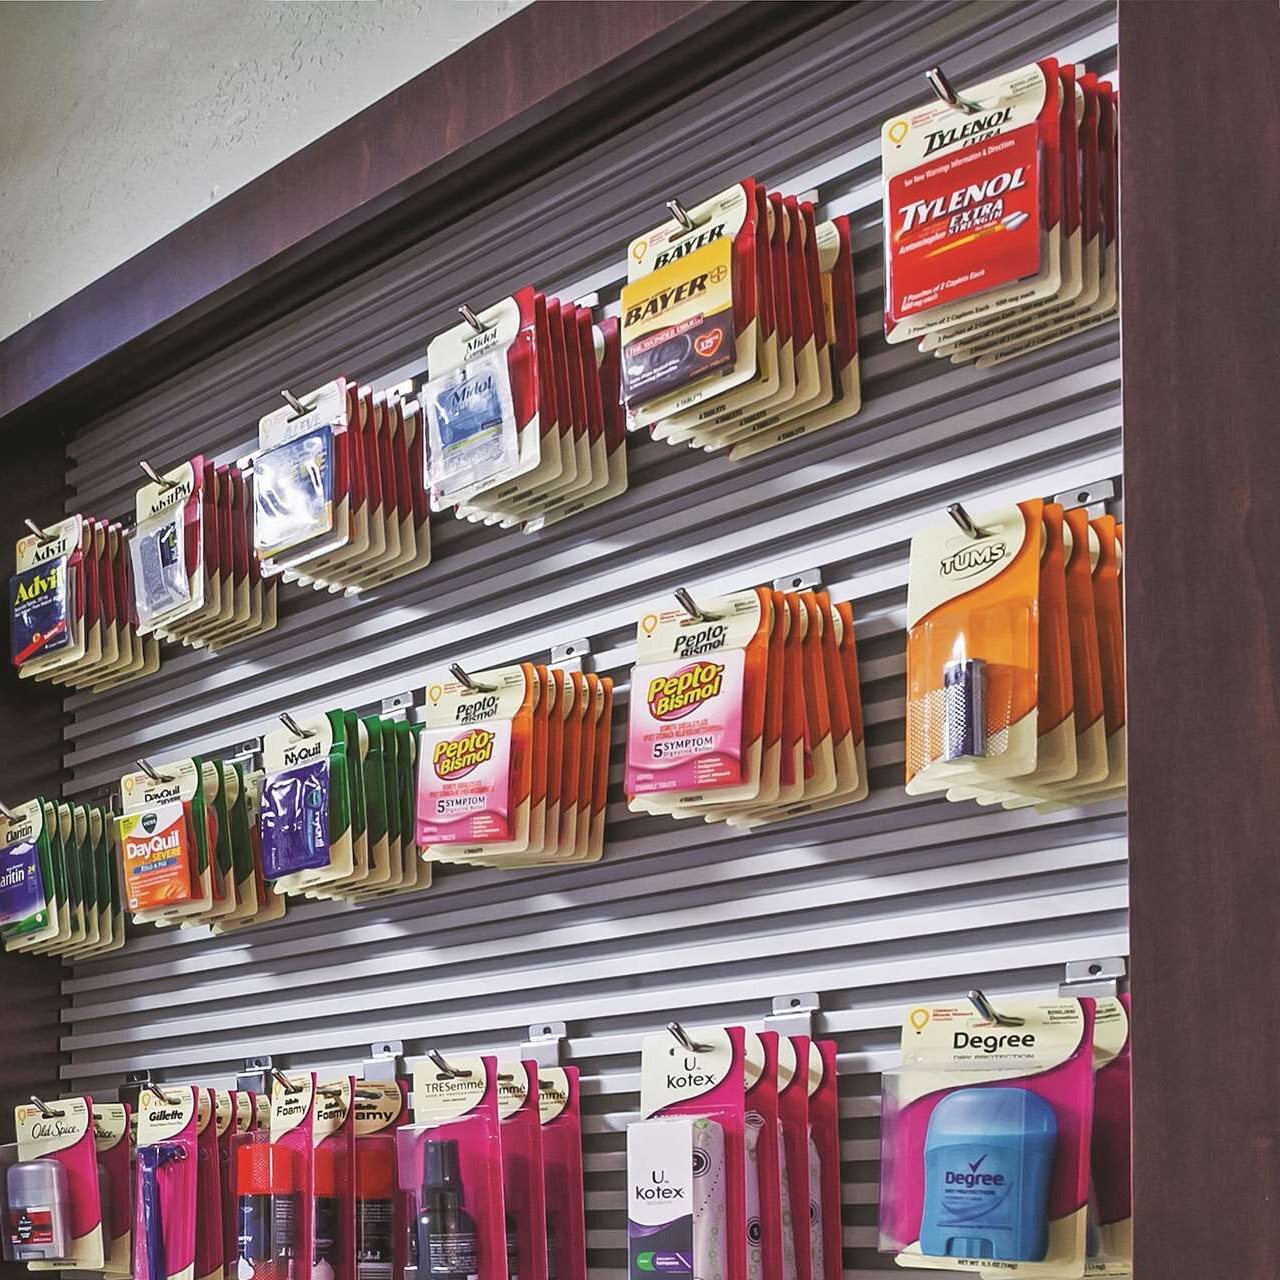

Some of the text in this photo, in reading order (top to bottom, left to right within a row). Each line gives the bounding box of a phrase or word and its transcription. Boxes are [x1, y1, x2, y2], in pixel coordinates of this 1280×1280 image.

[923, 106, 1013, 157] TYLENOL
[897, 167, 1027, 236] TYLENOL
[949, 199, 1003, 228] EXTRA
[654, 223, 725, 271] BAYER
[623, 273, 709, 329] BAYER
[466, 328, 498, 351] Midol
[174, 480, 192, 500] PM
[31, 539, 67, 565] Advil
[940, 541, 1007, 575] TUMS
[14, 566, 63, 605] Advil
[673, 624, 729, 654] Pepto-
[648, 663, 725, 703] Pepto-
[655, 679, 719, 717] Bismol
[284, 743, 322, 767] NyQuil
[433, 729, 497, 765] Pepto-
[653, 735, 714, 758] 5 SYMPTOM
[439, 744, 494, 779] Bismol
[437, 796, 486, 814] 5 SYMPTOM
[6, 824, 34, 844] Claritin
[126, 830, 180, 860] DayQuil
[953, 1030, 1035, 1053] Degree
[425, 1079, 484, 1093] TRESemmé
[666, 1073, 715, 1089] kotex
[148, 1110, 184, 1122] Gillette
[275, 1103, 307, 1117] Foamy
[316, 1106, 346, 1121] Foamy
[32, 1120, 79, 1139] Old Spice
[944, 1171, 1006, 1187] Degree
[635, 1186, 683, 1201] kotex
